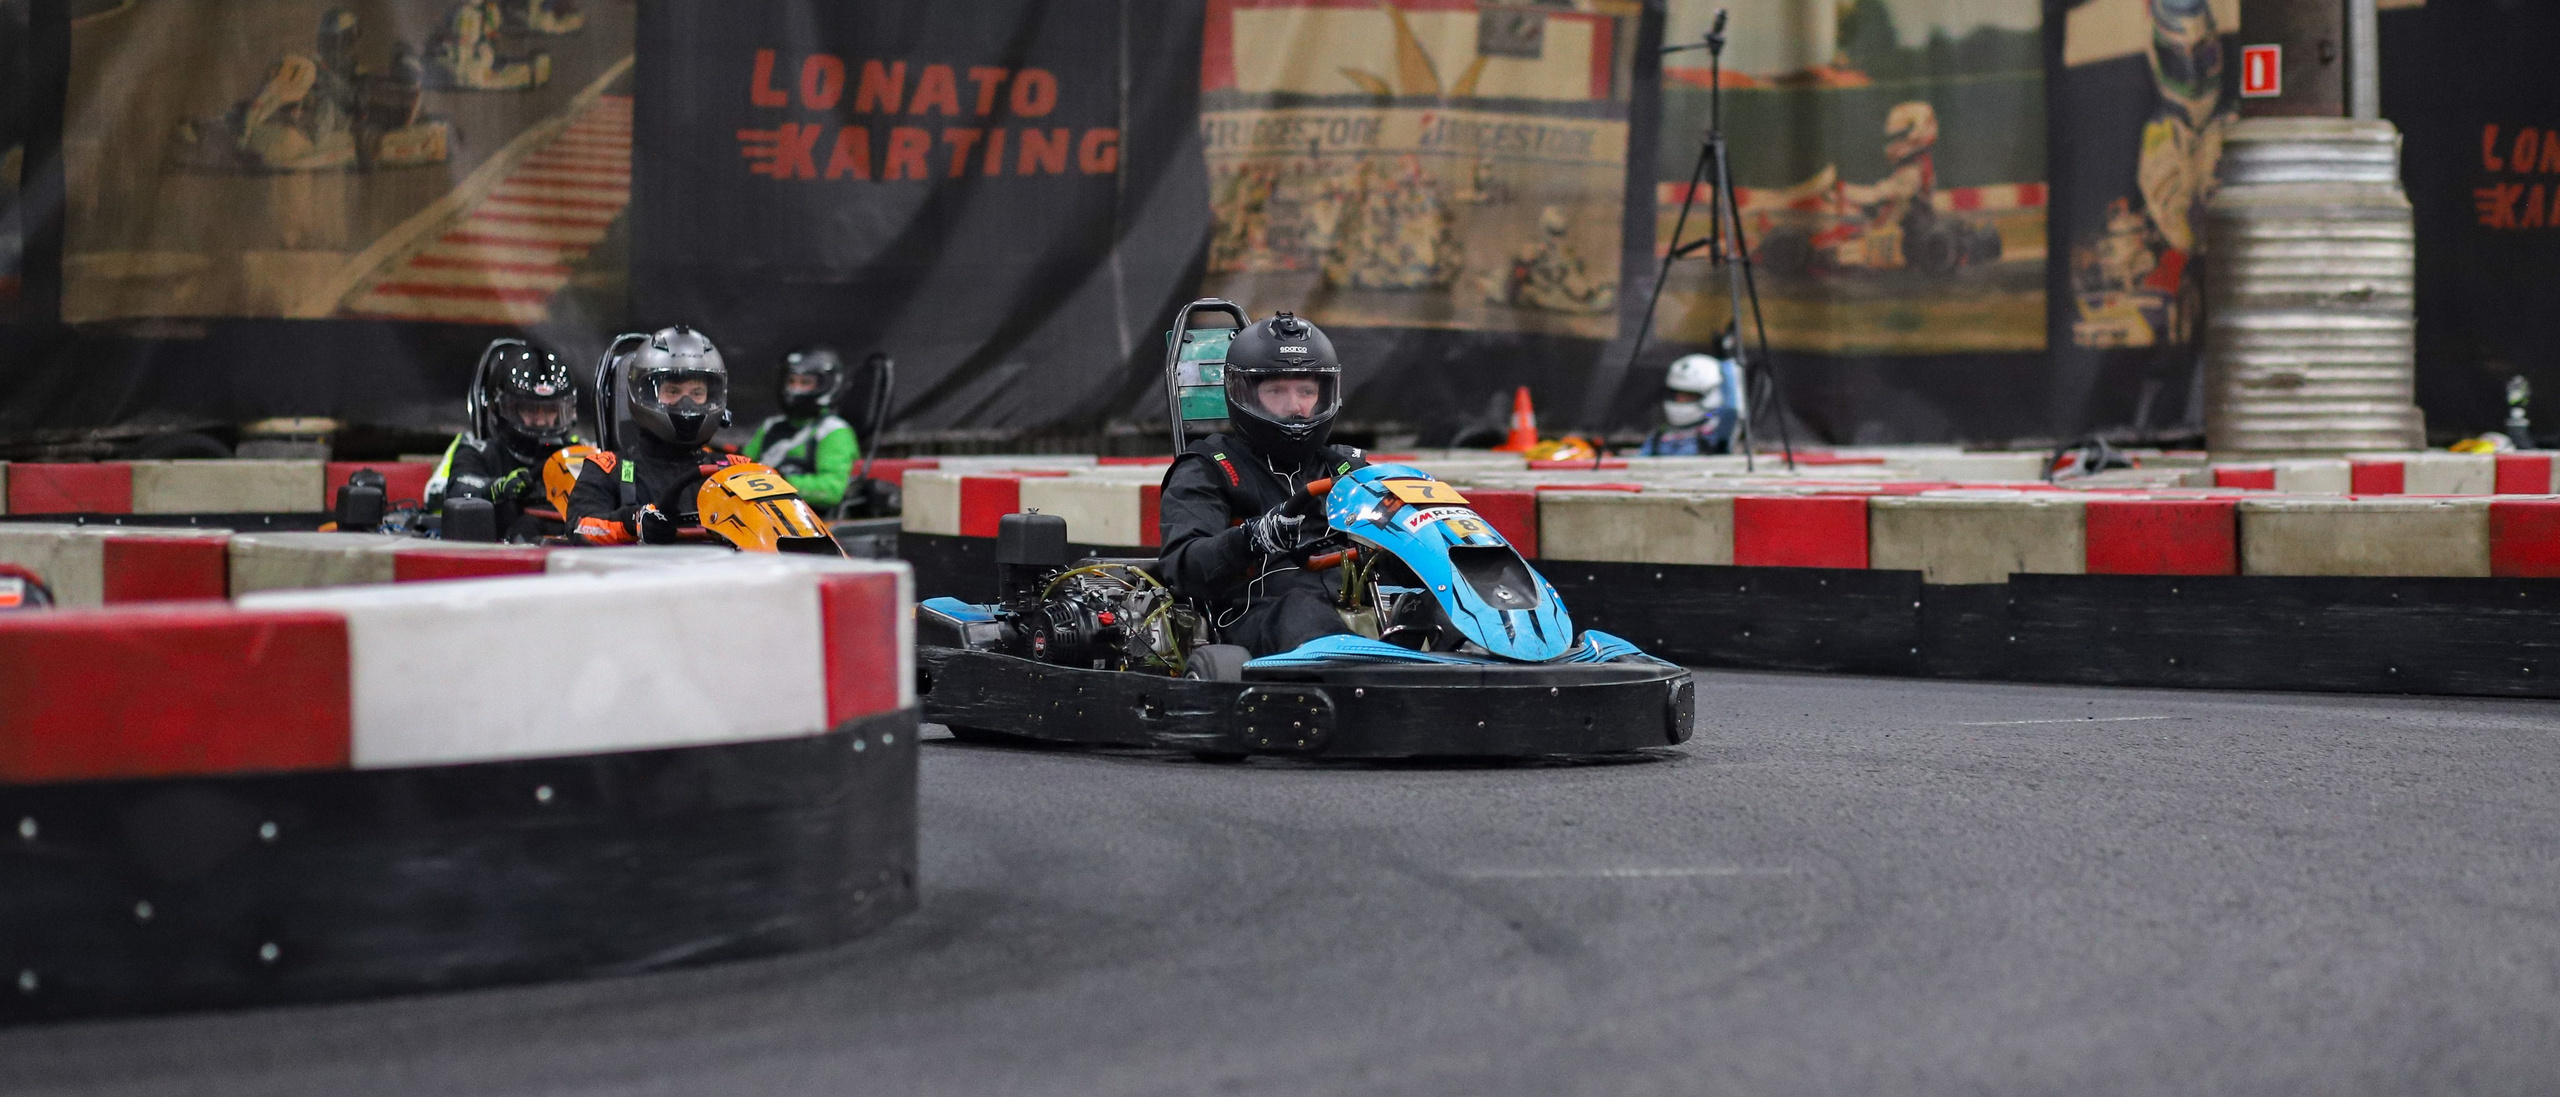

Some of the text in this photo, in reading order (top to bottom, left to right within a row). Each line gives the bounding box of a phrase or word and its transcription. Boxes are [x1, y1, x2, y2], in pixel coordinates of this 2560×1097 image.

[750, 48, 1058, 118] LONATO
[771, 122, 1120, 181] KARTING
[747, 478, 775, 492] 5
[1405, 485, 1436, 499] 7
[1459, 519, 1480, 531] 8
